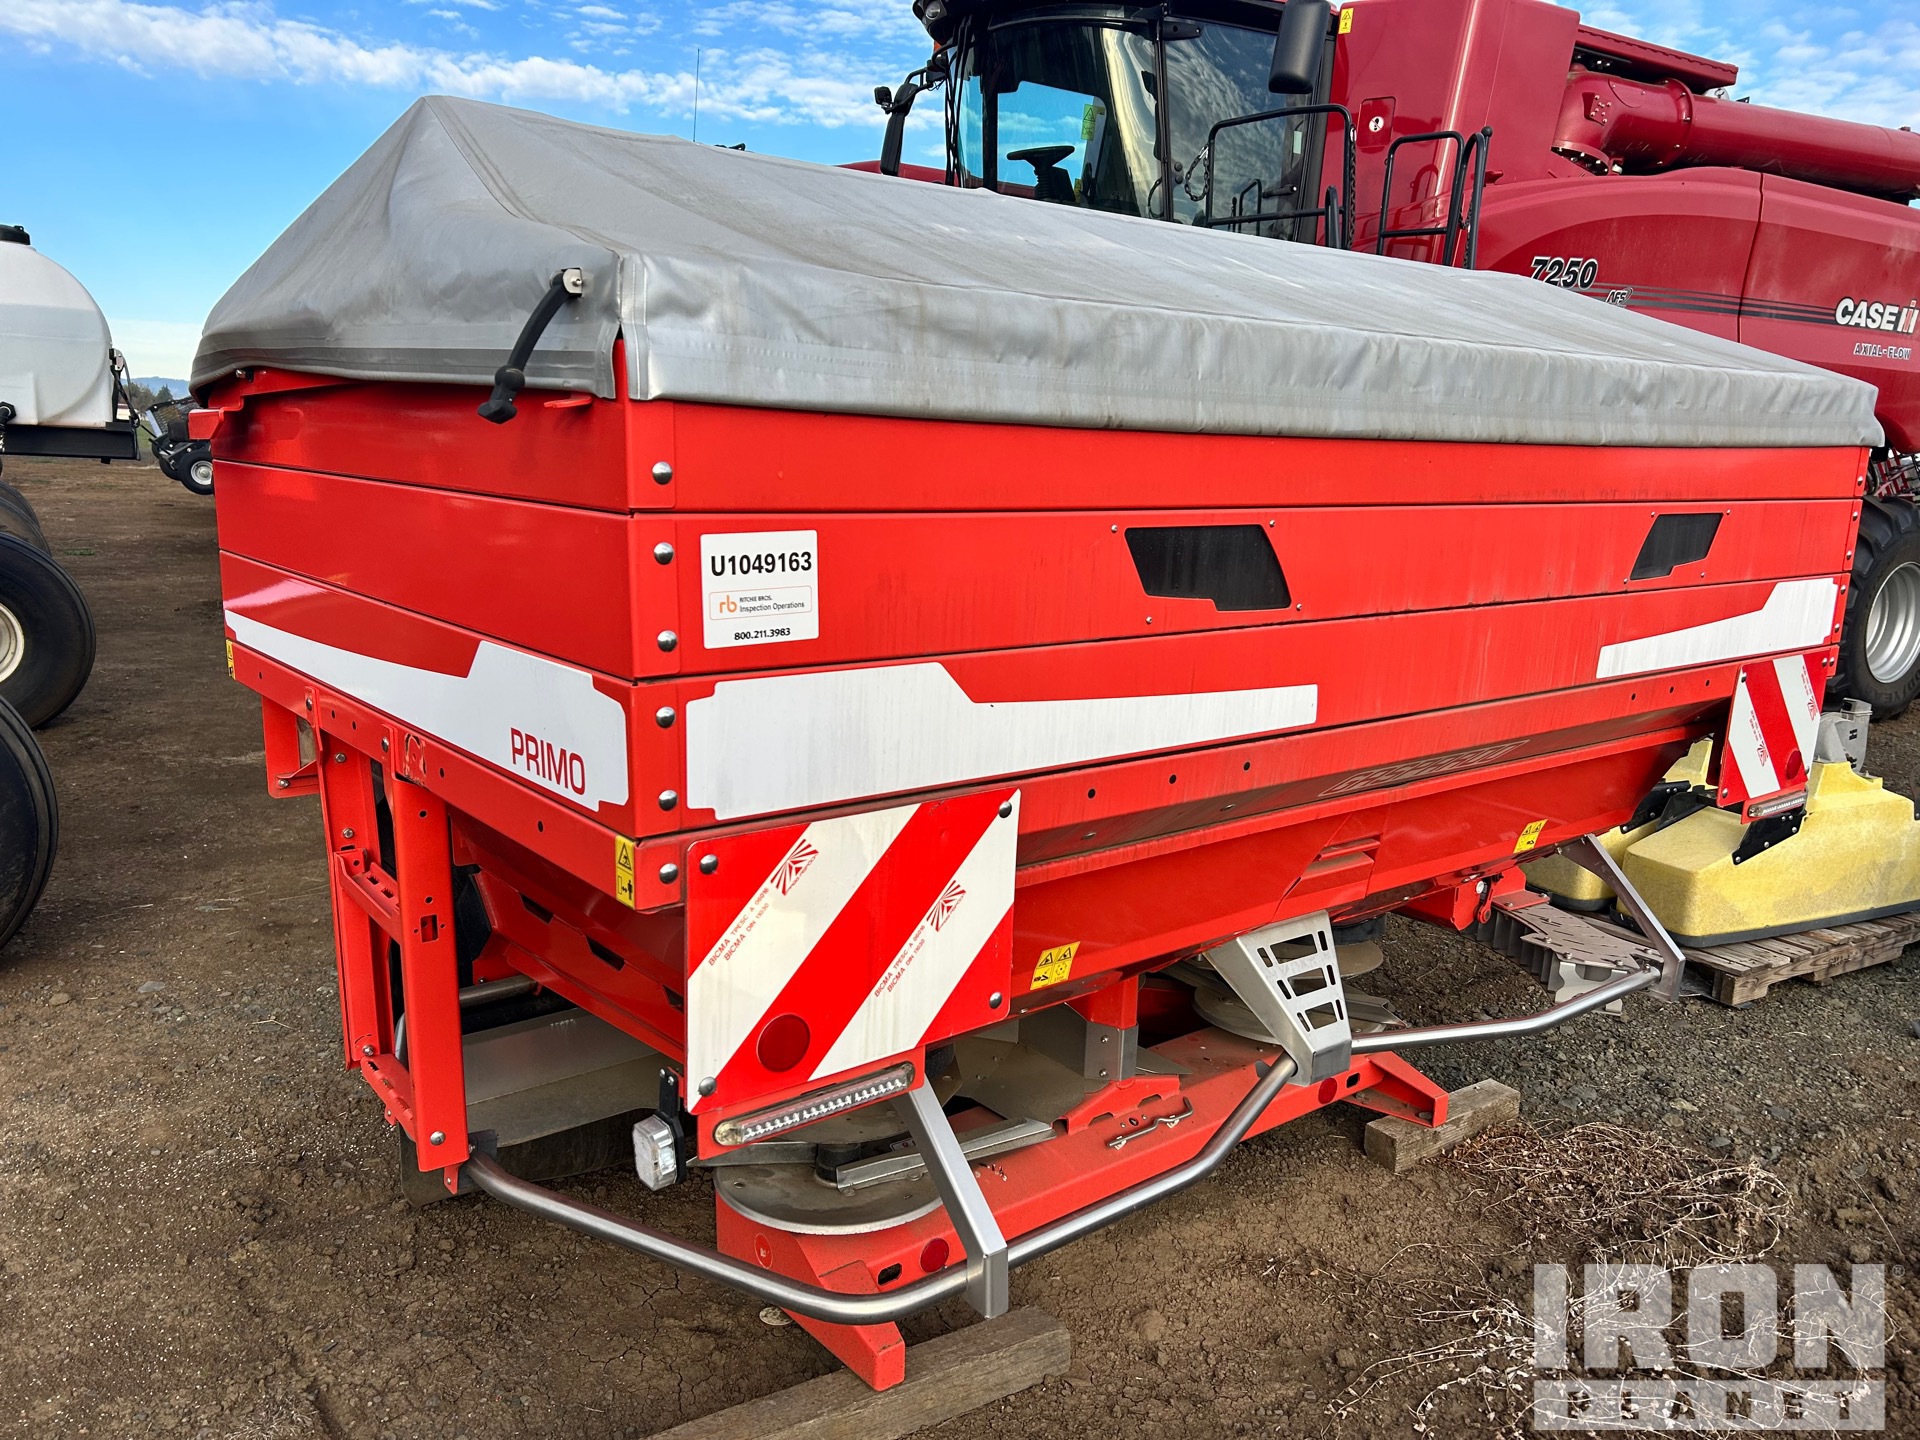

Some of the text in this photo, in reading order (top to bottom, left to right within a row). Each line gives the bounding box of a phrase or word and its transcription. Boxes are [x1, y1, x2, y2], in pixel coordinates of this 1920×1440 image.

[1530, 256, 1598, 289] 7250
[1835, 297, 1899, 331] CASE
[1853, 342, 1912, 360] AXIAL-FLOW
[710, 551, 813, 577] U1049163
[719, 594, 738, 614] rb
[739, 601, 805, 614] Inspection Operations
[734, 627, 791, 641] 800.211.3983
[510, 726, 586, 796] PRIMO
[1320, 741, 1529, 796] GASPARDO
[708, 938, 731, 966] BICMA
[723, 933, 746, 961] BICMA
[745, 920, 757, 932] DIN
[874, 972, 893, 997] BICMA
[887, 967, 906, 992] BICMA
[905, 955, 915, 966] DIN
